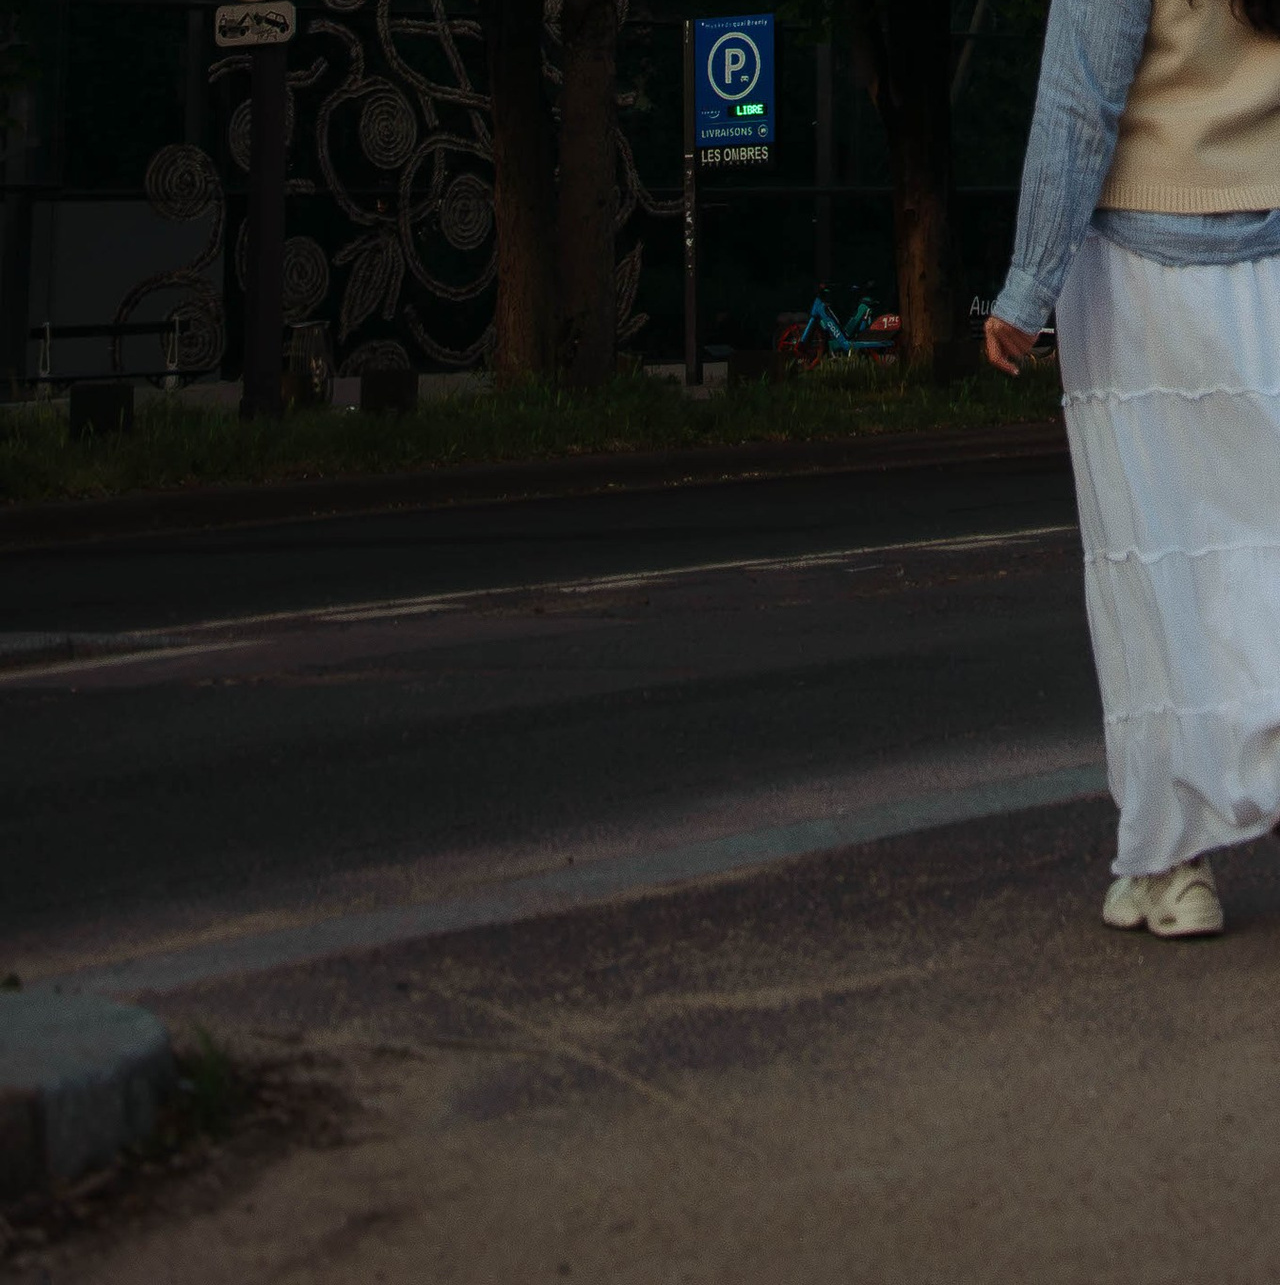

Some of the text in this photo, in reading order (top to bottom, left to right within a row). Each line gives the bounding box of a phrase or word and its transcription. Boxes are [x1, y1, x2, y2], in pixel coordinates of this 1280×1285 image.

[724, 48, 746, 84] P
[736, 104, 764, 116] LIBRE
[701, 126, 753, 139] LIVRAISONS
[701, 146, 769, 163] LES OMBRES
